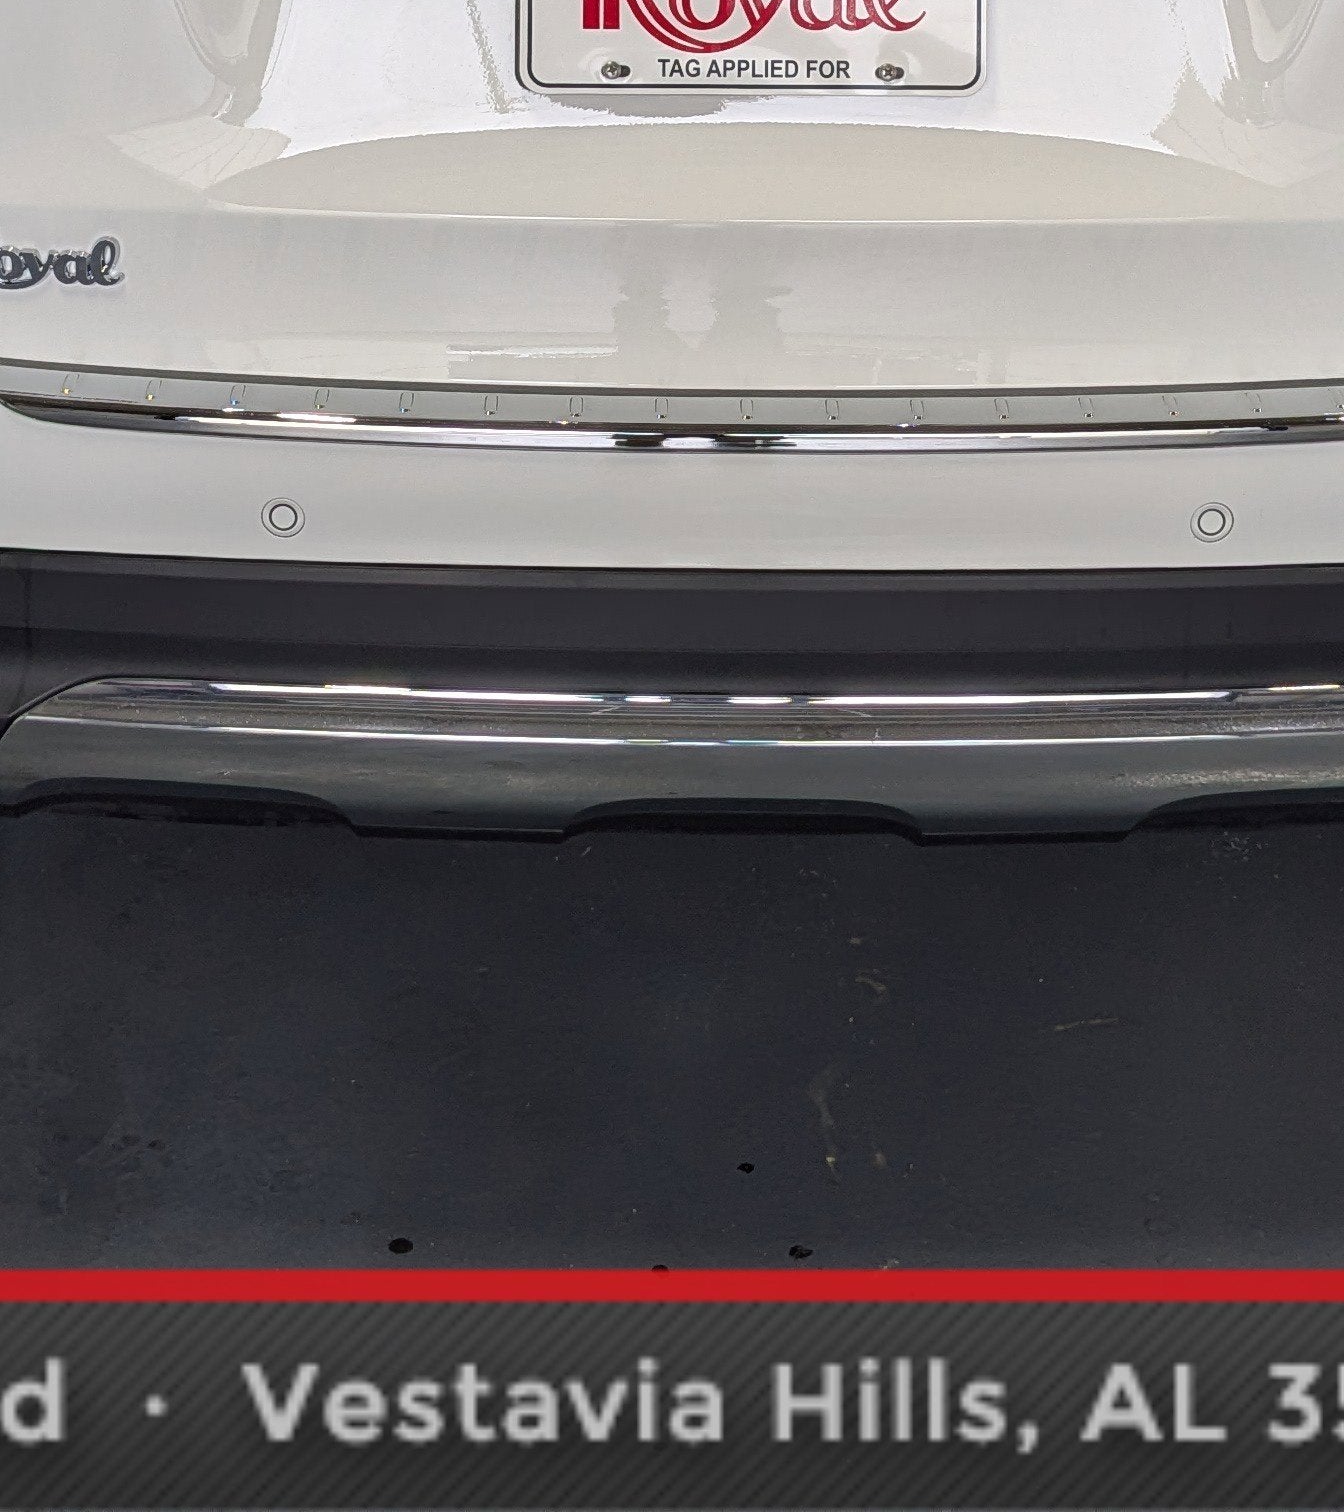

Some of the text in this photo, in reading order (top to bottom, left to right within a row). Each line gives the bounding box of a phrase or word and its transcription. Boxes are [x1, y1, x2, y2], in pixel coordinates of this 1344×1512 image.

[657, 59, 850, 80] TAG APPLIED FOR
